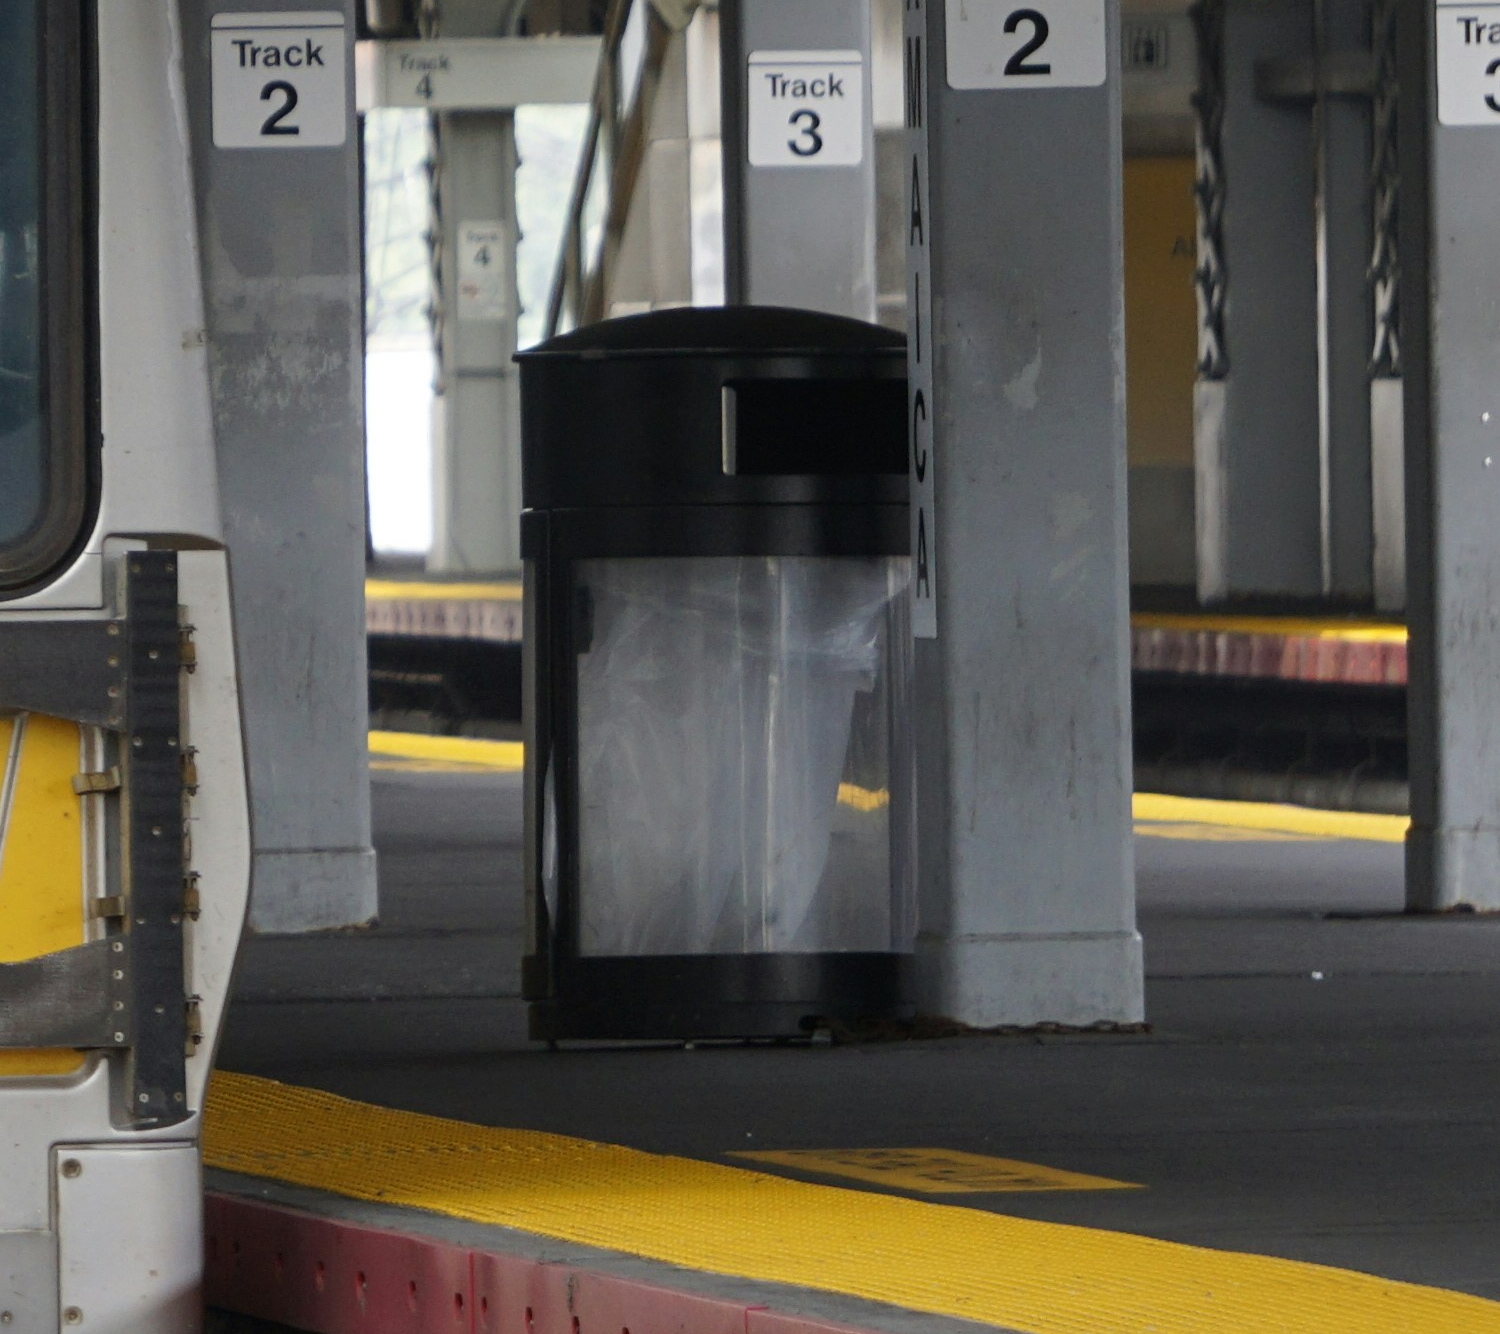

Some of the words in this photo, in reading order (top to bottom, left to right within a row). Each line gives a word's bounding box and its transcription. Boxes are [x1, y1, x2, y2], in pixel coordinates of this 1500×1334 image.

[231, 38, 324, 68] Track
[1003, 8, 1051, 76] 2
[260, 80, 300, 136] 2
[765, 73, 844, 98] Track
[788, 109, 823, 157] 3
